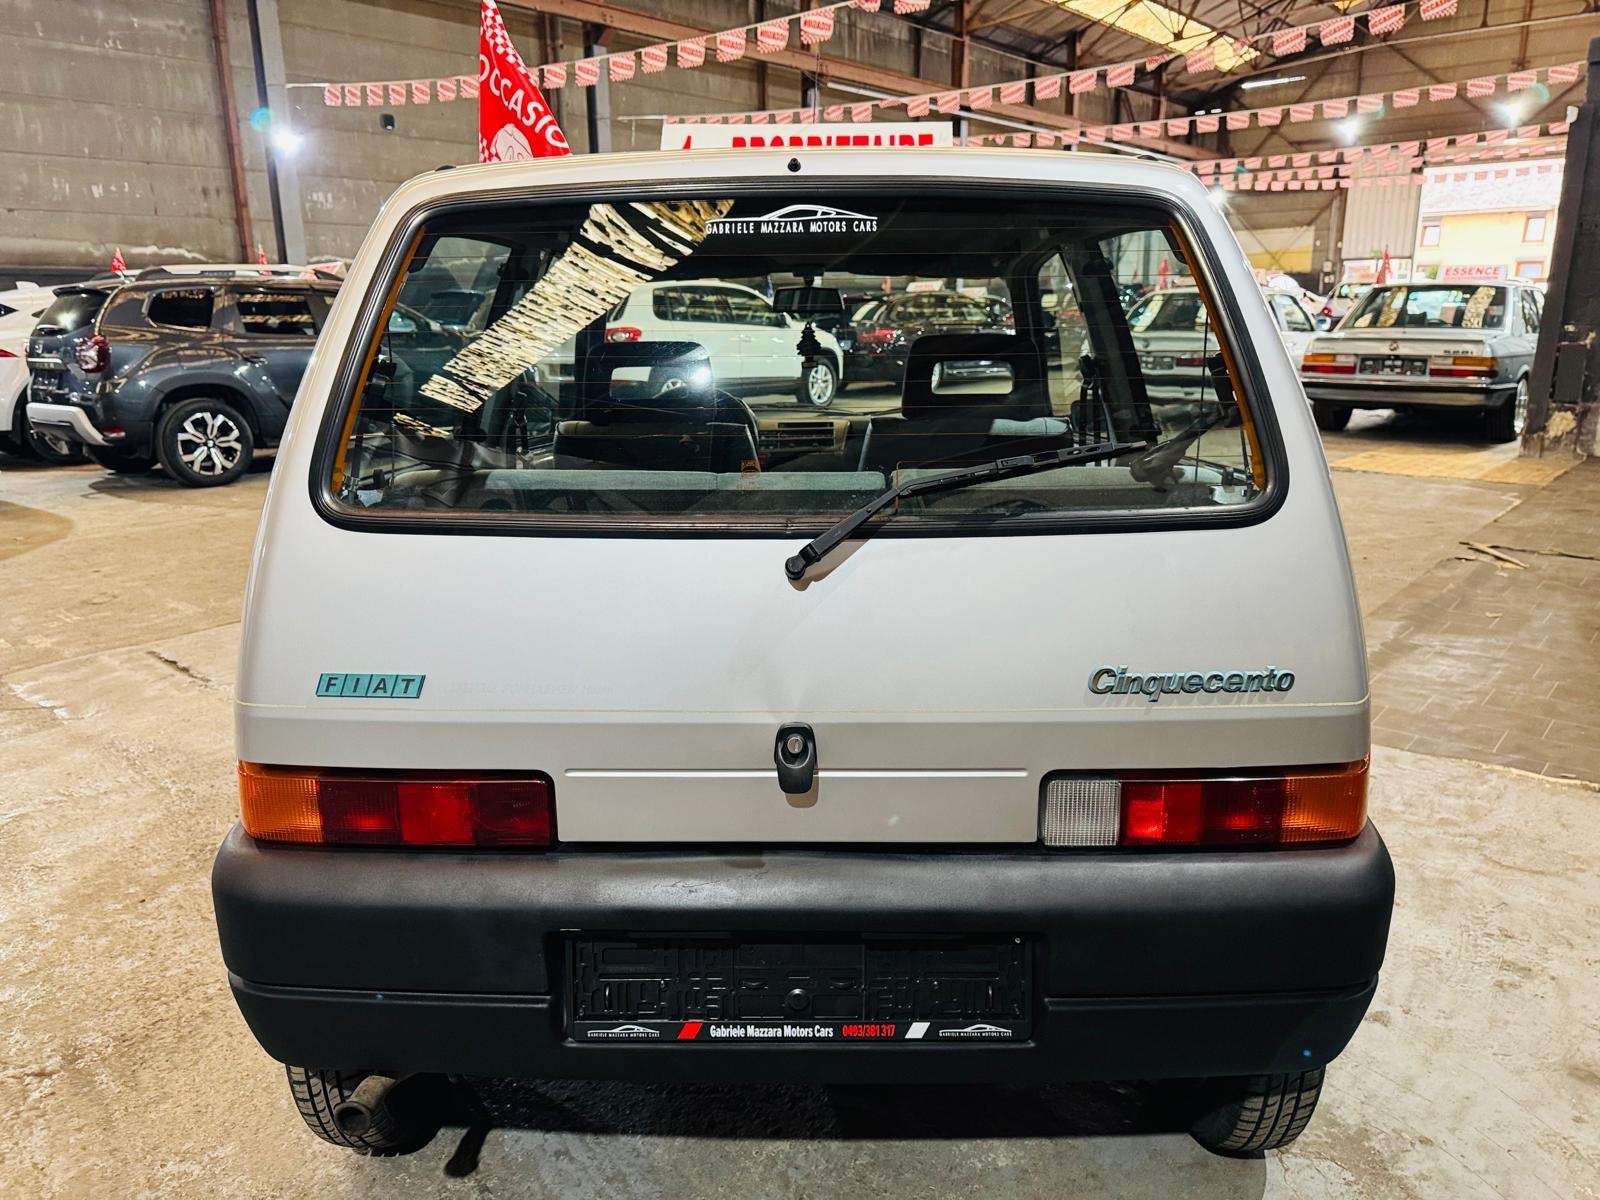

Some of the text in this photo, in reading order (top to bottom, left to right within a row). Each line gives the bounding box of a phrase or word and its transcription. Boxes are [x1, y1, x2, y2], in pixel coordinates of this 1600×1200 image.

[705, 221, 878, 234] GABRIELE MAZZARA MOTORS CARS
[1445, 267, 1500, 276] ESSENCE
[323, 676, 418, 695] FIAT
[1088, 664, 1296, 702] Cinquecento
[709, 1024, 833, 1038] Gabriele Mazzara Motors Cars
